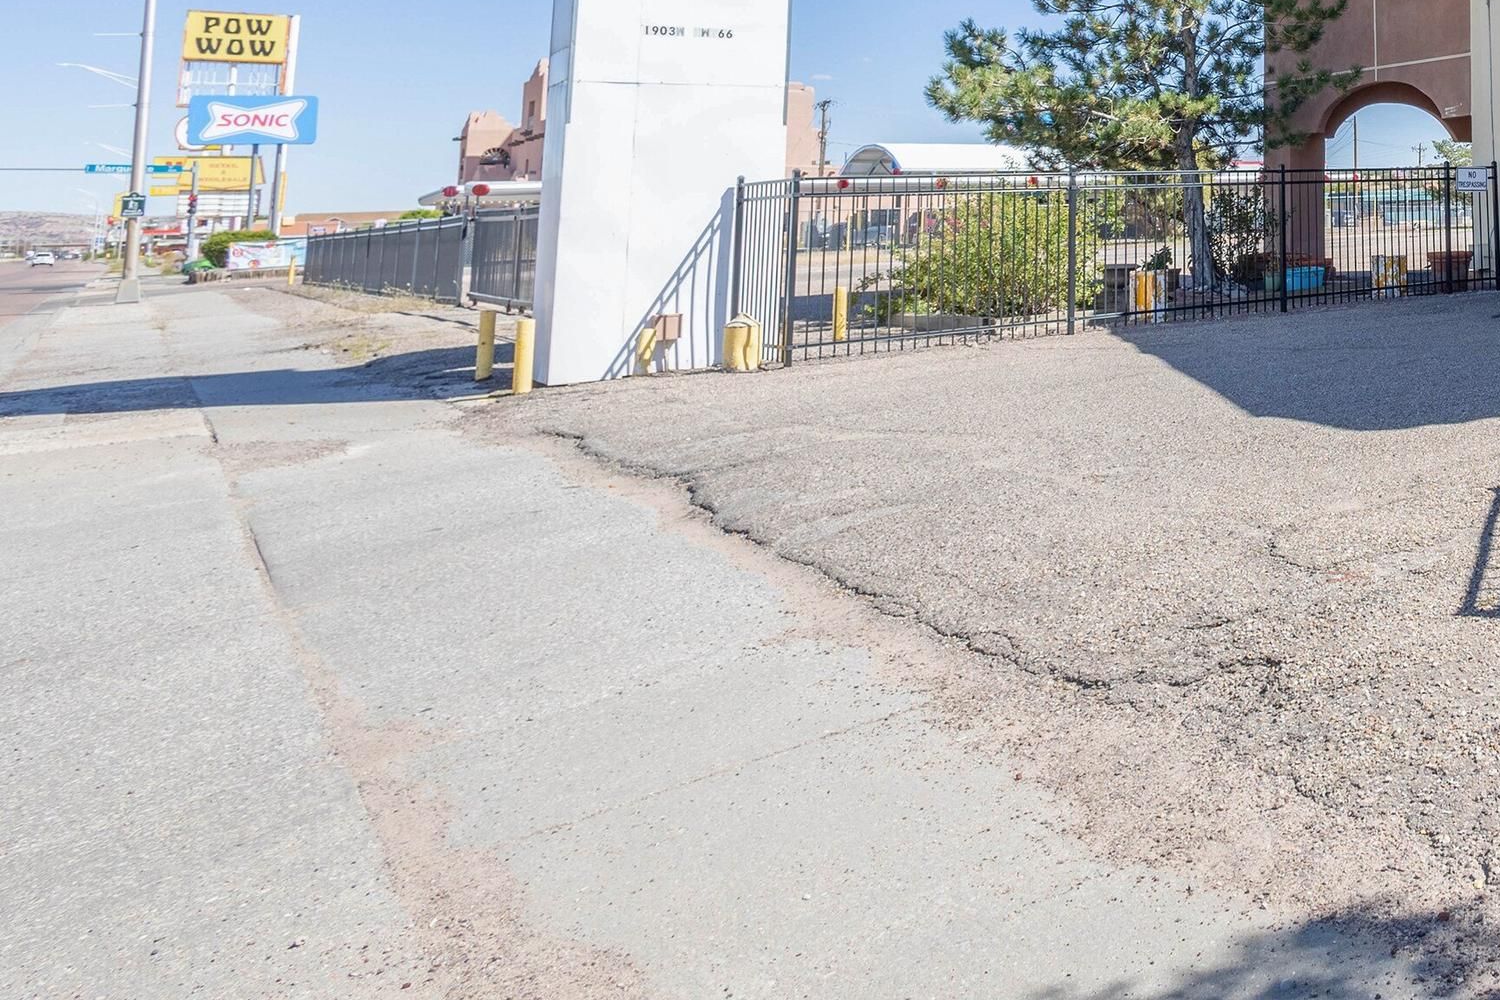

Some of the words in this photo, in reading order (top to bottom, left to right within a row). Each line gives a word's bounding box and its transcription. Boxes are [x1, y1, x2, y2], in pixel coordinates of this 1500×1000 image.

[204, 16, 273, 35] POW
[718, 29, 733, 39] 66
[196, 37, 276, 56] WOW
[217, 114, 289, 127] SONIC
[1468, 171, 1477, 179] NO
